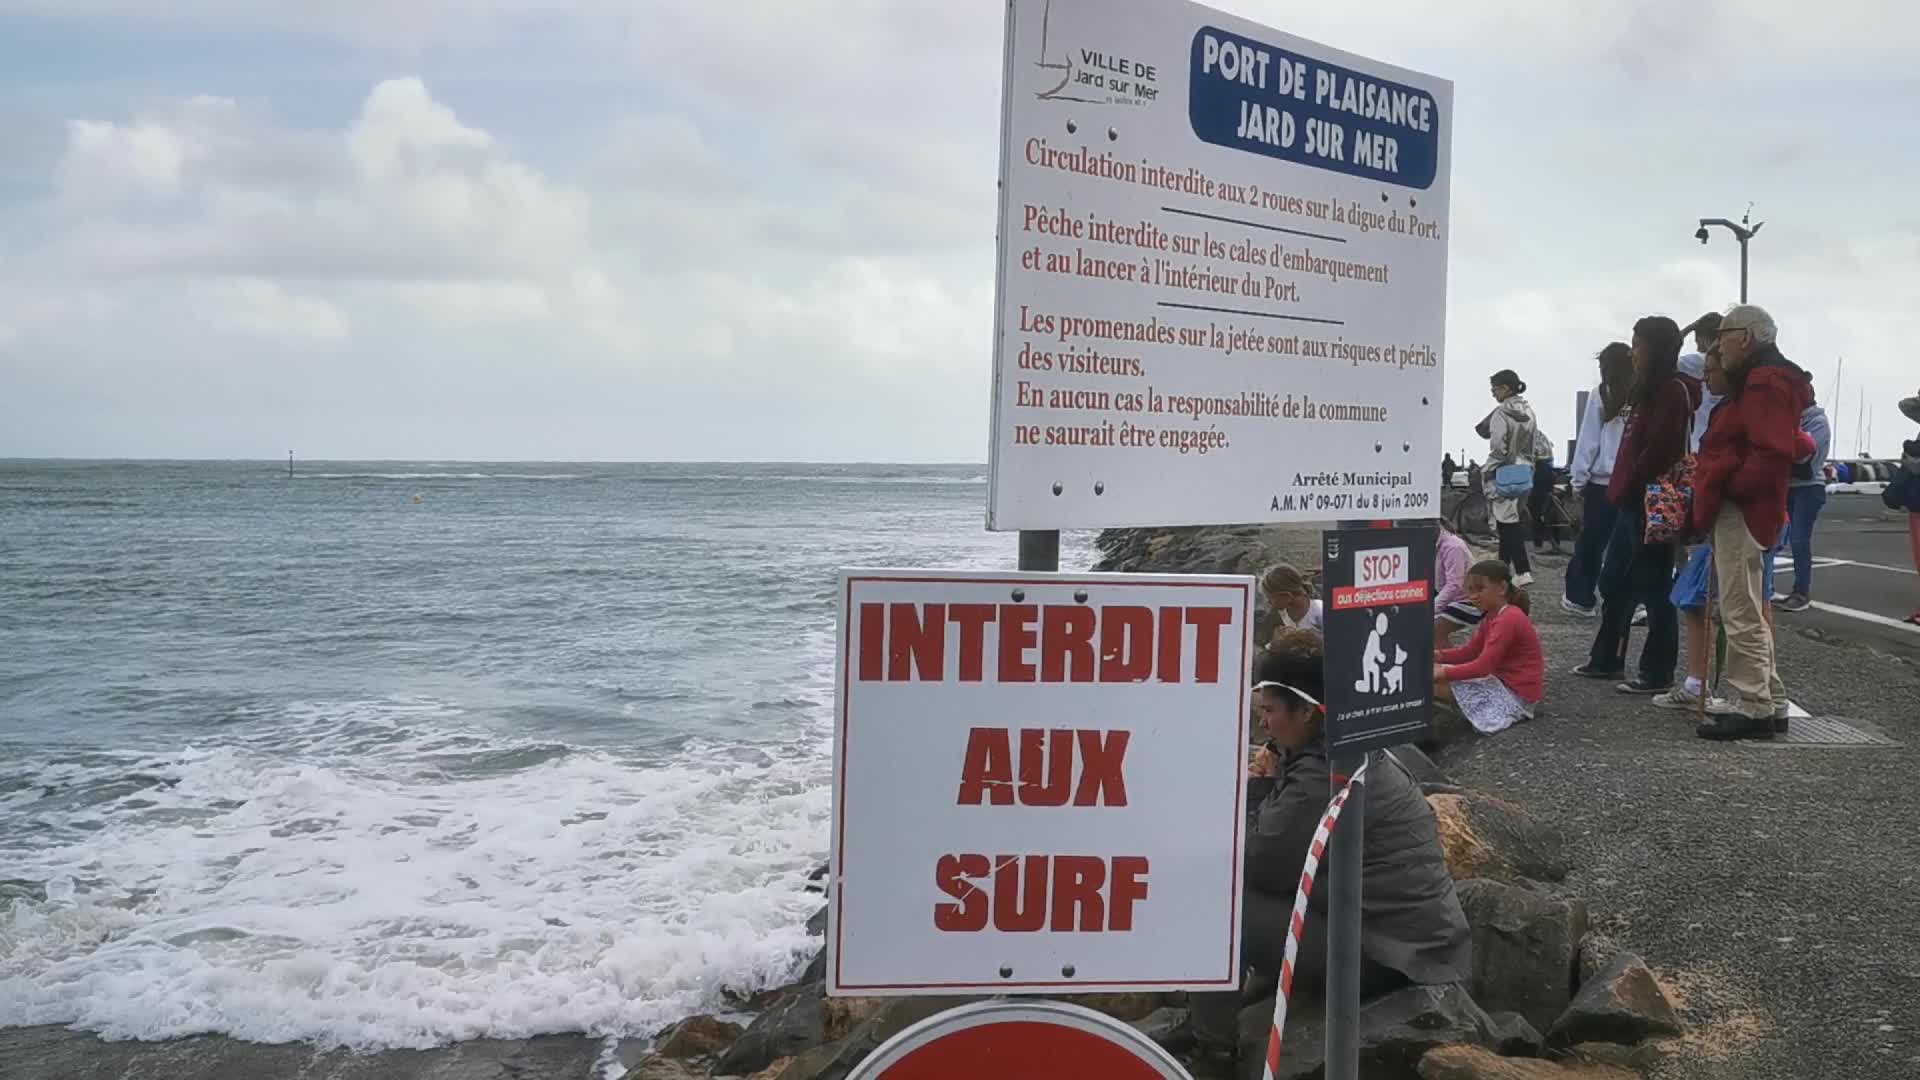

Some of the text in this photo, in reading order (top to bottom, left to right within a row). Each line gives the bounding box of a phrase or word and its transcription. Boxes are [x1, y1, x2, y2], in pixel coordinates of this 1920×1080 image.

[1074, 69, 1159, 101] Jard sur Mer
[1081, 48, 1157, 82] VILLE DE
[1203, 34, 1431, 132] PORT DE PLAISANCE
[1237, 100, 1399, 173] JARD SUR MER
[1025, 137, 1441, 240] Circulation interdite aux 2 roues sur la digue du Port.
[1023, 204, 1389, 284] Pêche interdite sur les cales d'embarquement
[1021, 247, 1300, 302] et au lancer à l'intérieur du Port.
[1017, 342, 1145, 376] des visiteurs.
[1019, 305, 1437, 370] Les promenades sur la jetée sont aux risques et périls
[1016, 381, 1387, 422] En aucun cas la responsabilité de la commune
[1015, 420, 1230, 454] ne saurait être engagée.
[1270, 493, 1429, 512] A.M. N° 09-071 du 8 juin 2009
[1292, 471, 1412, 488] Arrêté Municipal
[1363, 554, 1401, 581] STOP
[1337, 593, 1352, 605] aux
[859, 602, 1232, 683] INTERDIT
[957, 727, 1130, 807] AUX
[934, 853, 1149, 932] SURF
